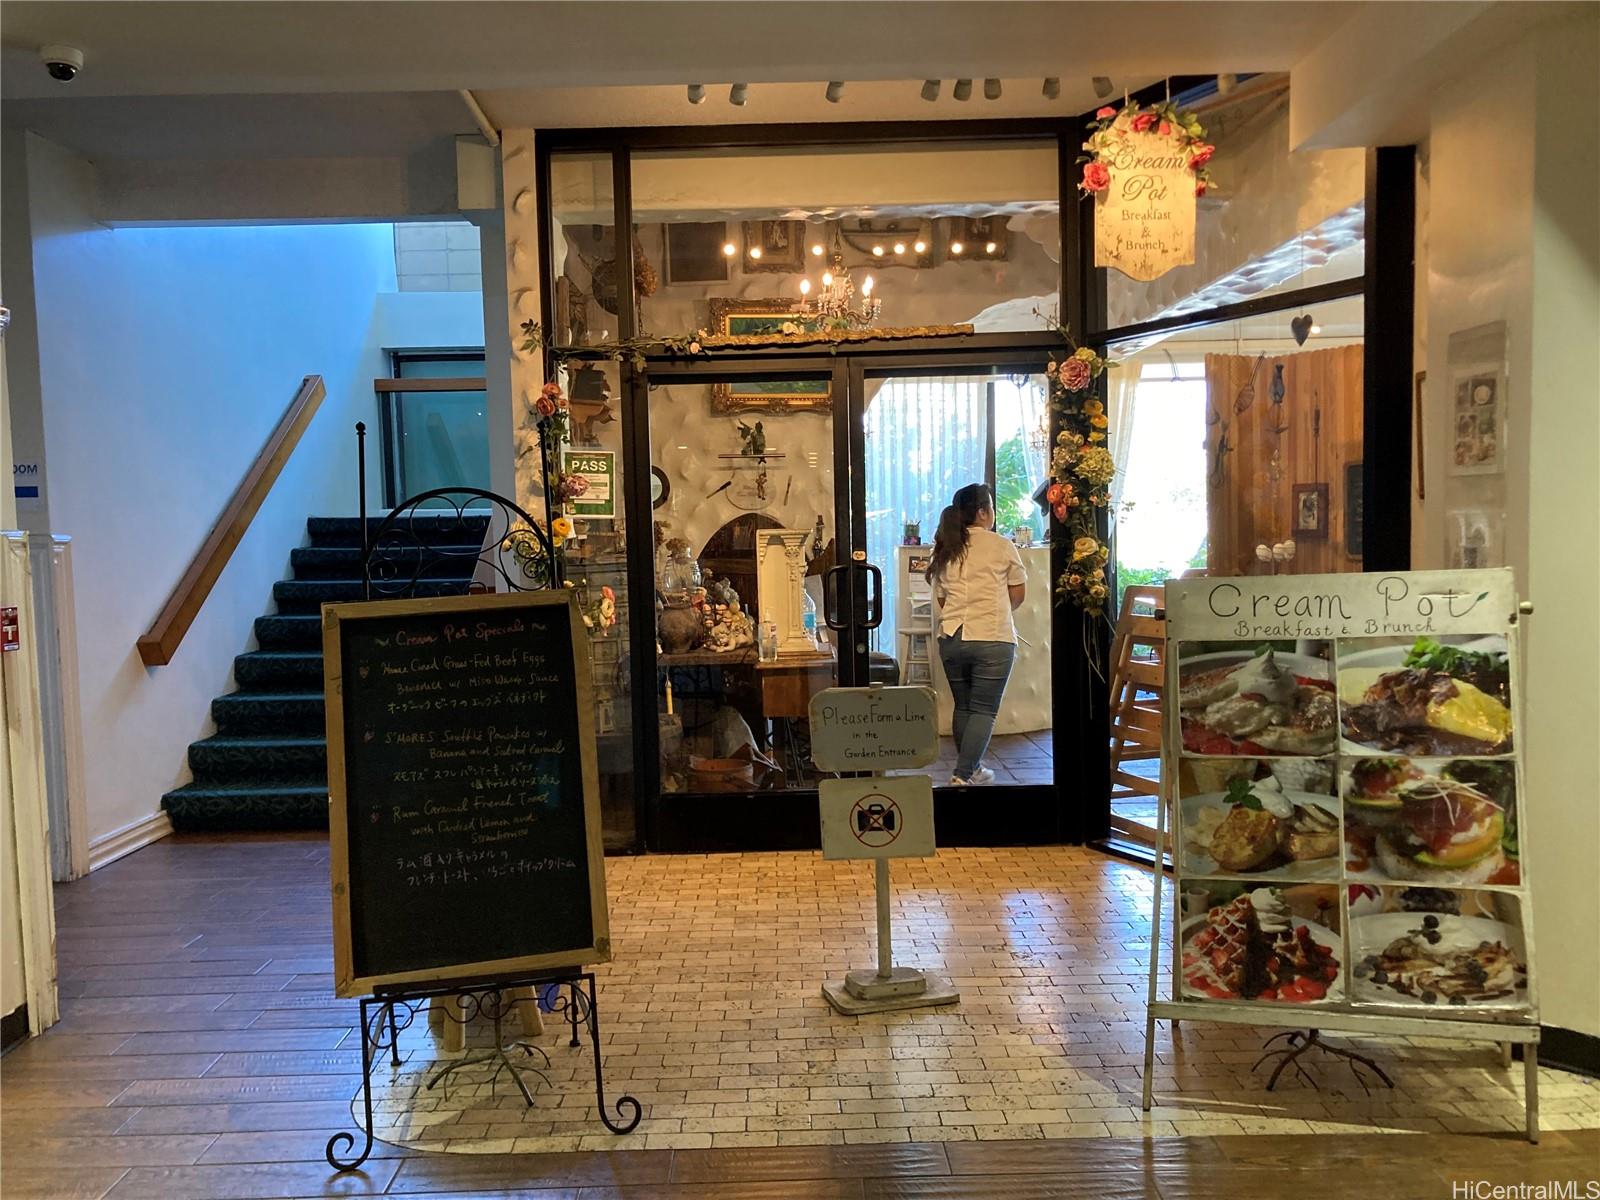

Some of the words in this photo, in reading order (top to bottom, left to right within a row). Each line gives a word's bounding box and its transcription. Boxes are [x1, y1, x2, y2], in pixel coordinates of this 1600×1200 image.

[1108, 142, 1186, 170] Cream
[1121, 174, 1168, 201] Pot
[1121, 210, 1171, 221] Breakfast
[1140, 226, 1152, 239] &
[1125, 240, 1165, 250] Brunch
[571, 460, 607, 472] PASS
[1209, 583, 1352, 620] Cream
[1376, 576, 1484, 618] Pot
[444, 624, 468, 643] Pot
[475, 618, 525, 641] Specials
[1233, 620, 1334, 638] Breakfast
[1364, 617, 1438, 635] Brunch
[494, 648, 518, 667] Beef
[522, 651, 546, 667] Eggs
[527, 672, 560, 686] Sauce
[822, 706, 868, 727] Please
[870, 703, 894, 724] Form
[904, 703, 927, 722] Line
[852, 730, 861, 739] in
[865, 730, 879, 740] the
[429, 747, 467, 760] Banana
[469, 744, 490, 757] and
[844, 747, 876, 759] Garden
[878, 747, 918, 758] Entrance
[393, 806, 420, 824] Rum
[423, 799, 468, 818] Caramel
[472, 795, 515, 813] French
[410, 824, 435, 837] with
[513, 811, 537, 824] and
